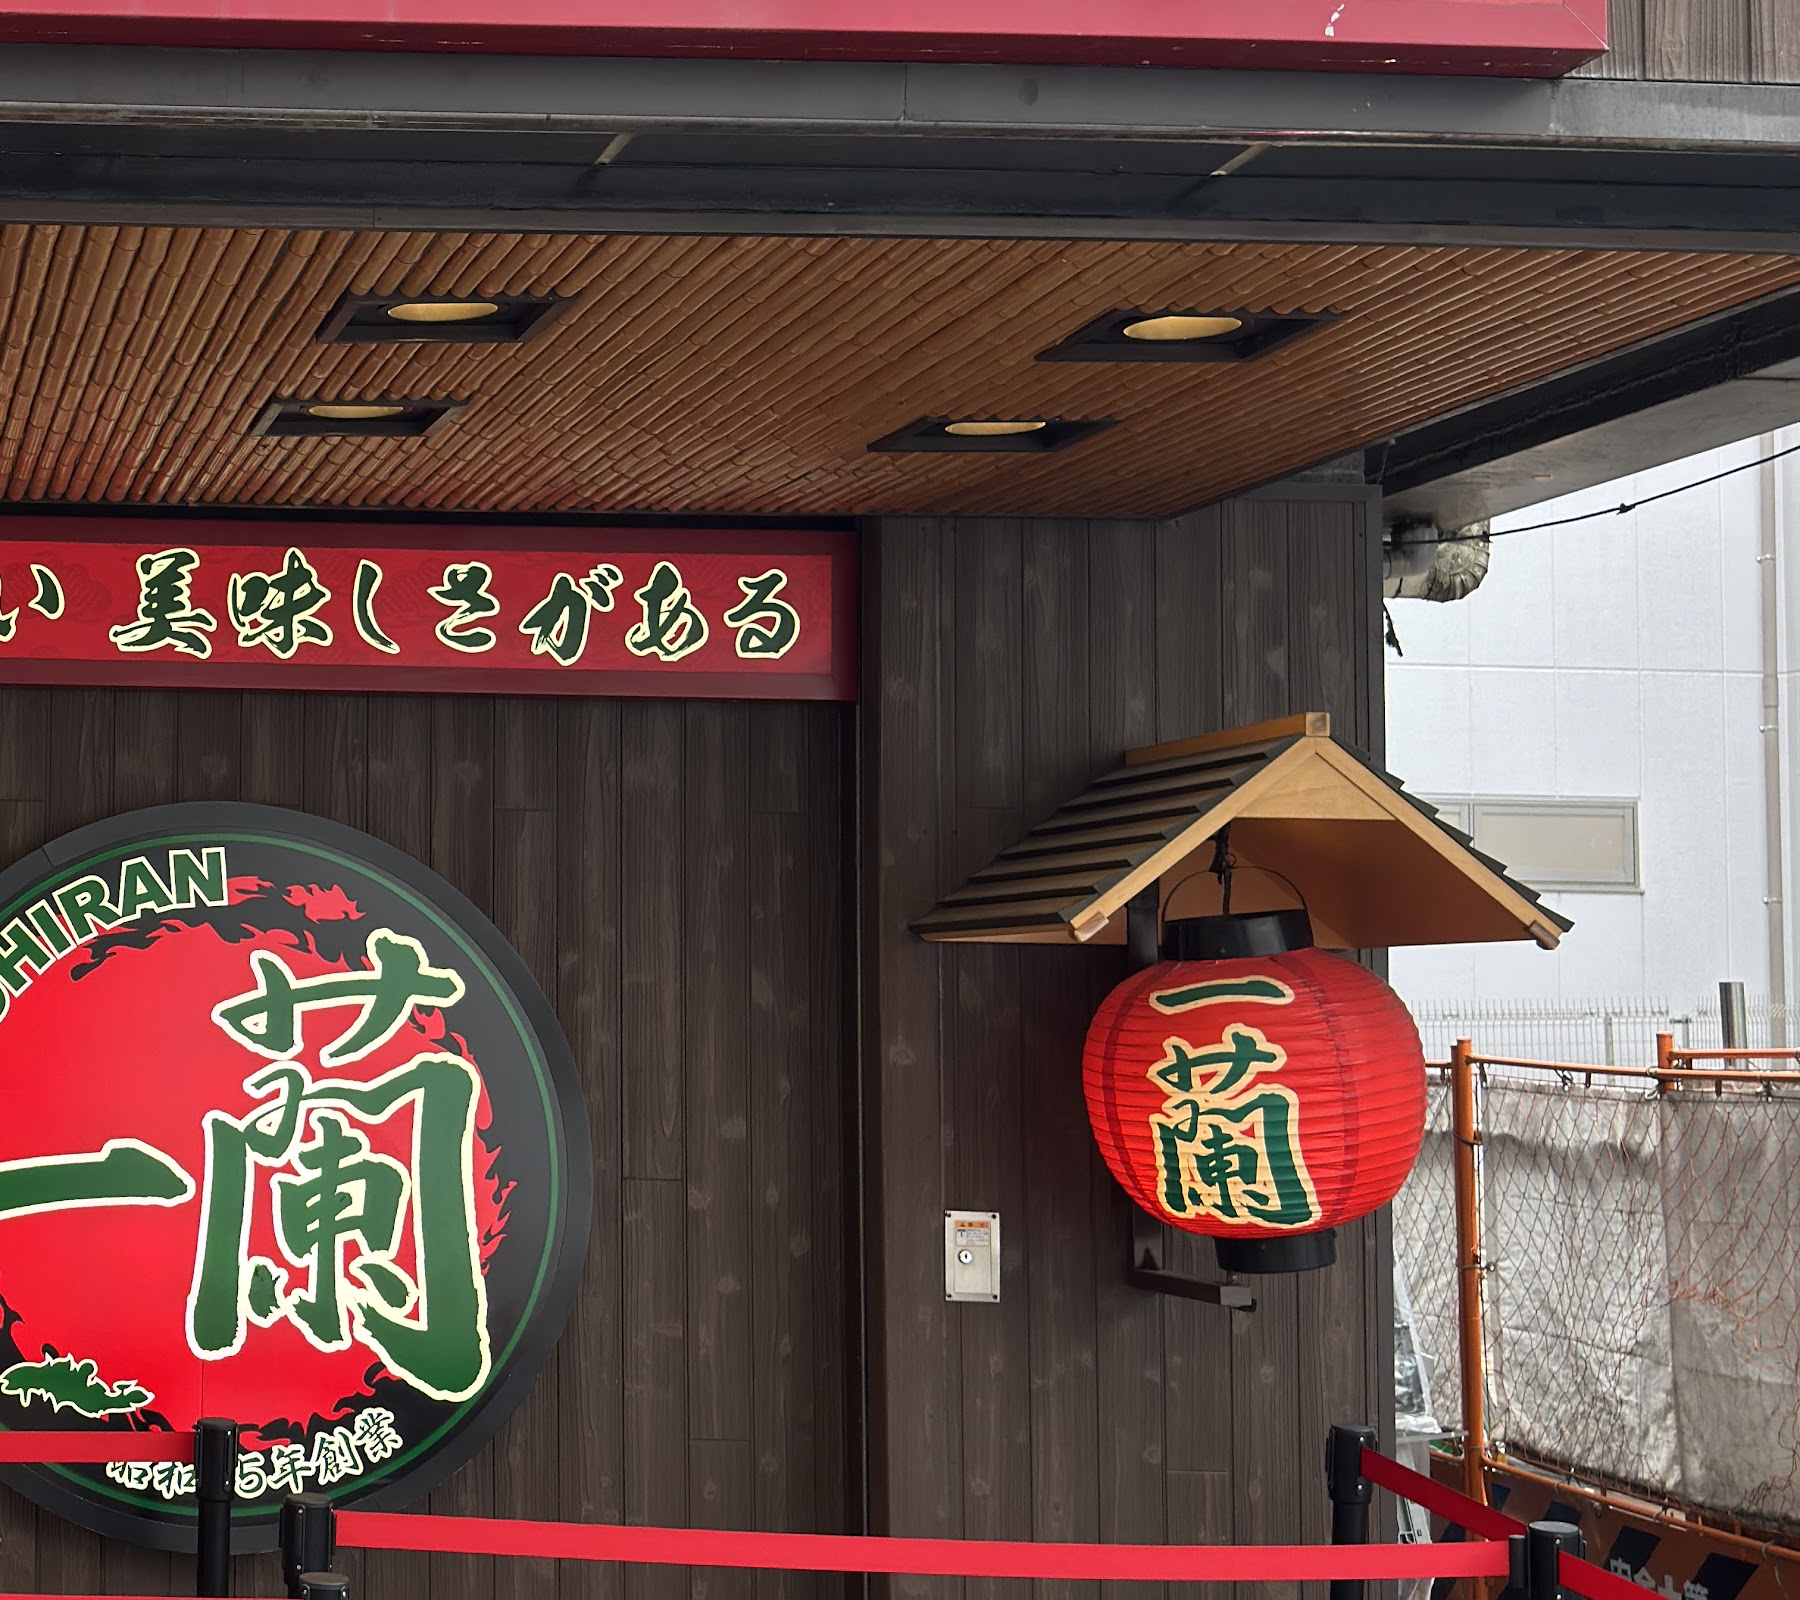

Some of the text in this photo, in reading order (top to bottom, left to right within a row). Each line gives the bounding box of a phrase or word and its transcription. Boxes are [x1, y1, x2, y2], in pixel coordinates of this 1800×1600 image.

[107, 547, 802, 667] 美味しさがある
[1147, 974, 1324, 1229] 一蘭
[105, 1406, 404, 1500] 昭和5年創業
